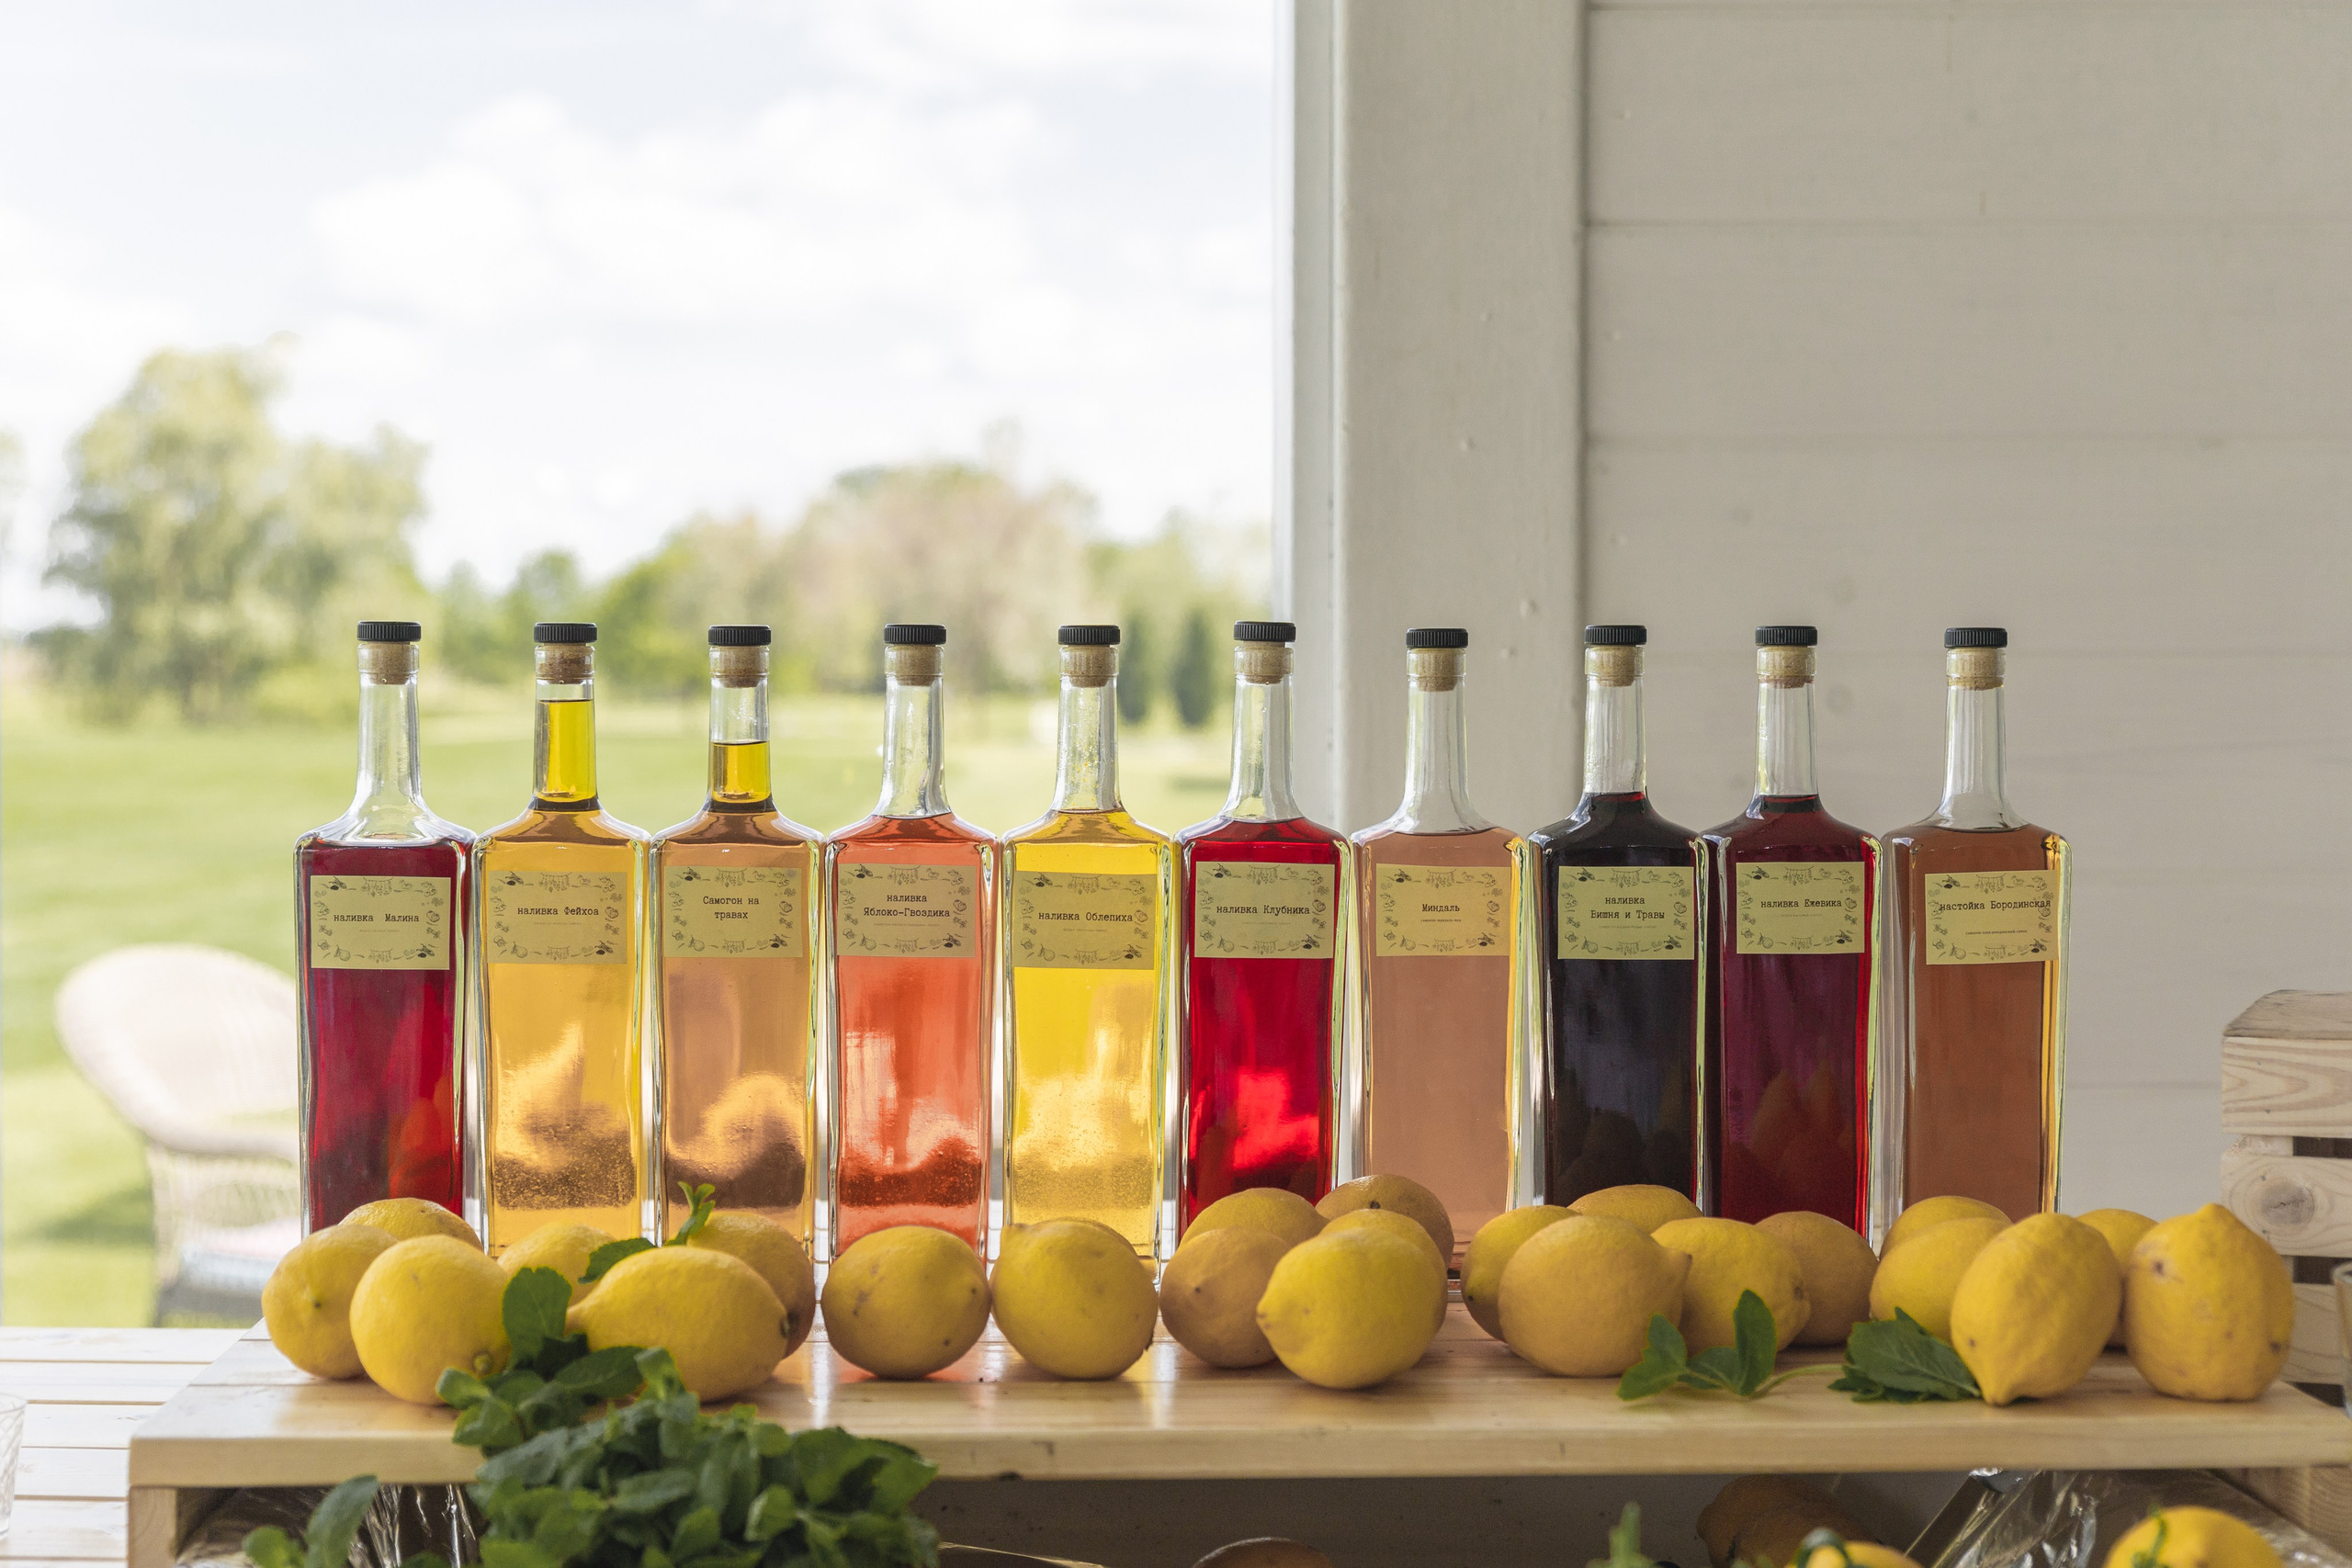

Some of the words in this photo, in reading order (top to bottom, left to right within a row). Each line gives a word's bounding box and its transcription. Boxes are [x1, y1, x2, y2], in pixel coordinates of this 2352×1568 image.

[703, 897, 742, 905] Самогон
[887, 895, 927, 903] наливка
[1605, 897, 1645, 905] наливка
[1760, 900, 1799, 908] наливка
[1804, 898, 1842, 908] Ежевика
[1421, 904, 1460, 912] Миндаль
[1940, 901, 1985, 911] настойка
[1990, 900, 2051, 911] Бородинская
[517, 907, 559, 915] наливка
[564, 907, 599, 916] Фейхоа
[864, 908, 950, 918] Яблоко-Гвоздика
[1216, 906, 1258, 914] наливка
[1263, 905, 1310, 916] Клубника
[1590, 910, 1620, 919] Вишня
[1636, 910, 1665, 920] Травы
[334, 914, 374, 922] наливка
[385, 913, 419, 922] Малина
[715, 912, 748, 920] травах
[1038, 912, 1080, 920] наливка
[1086, 912, 1133, 922] Облепиха
